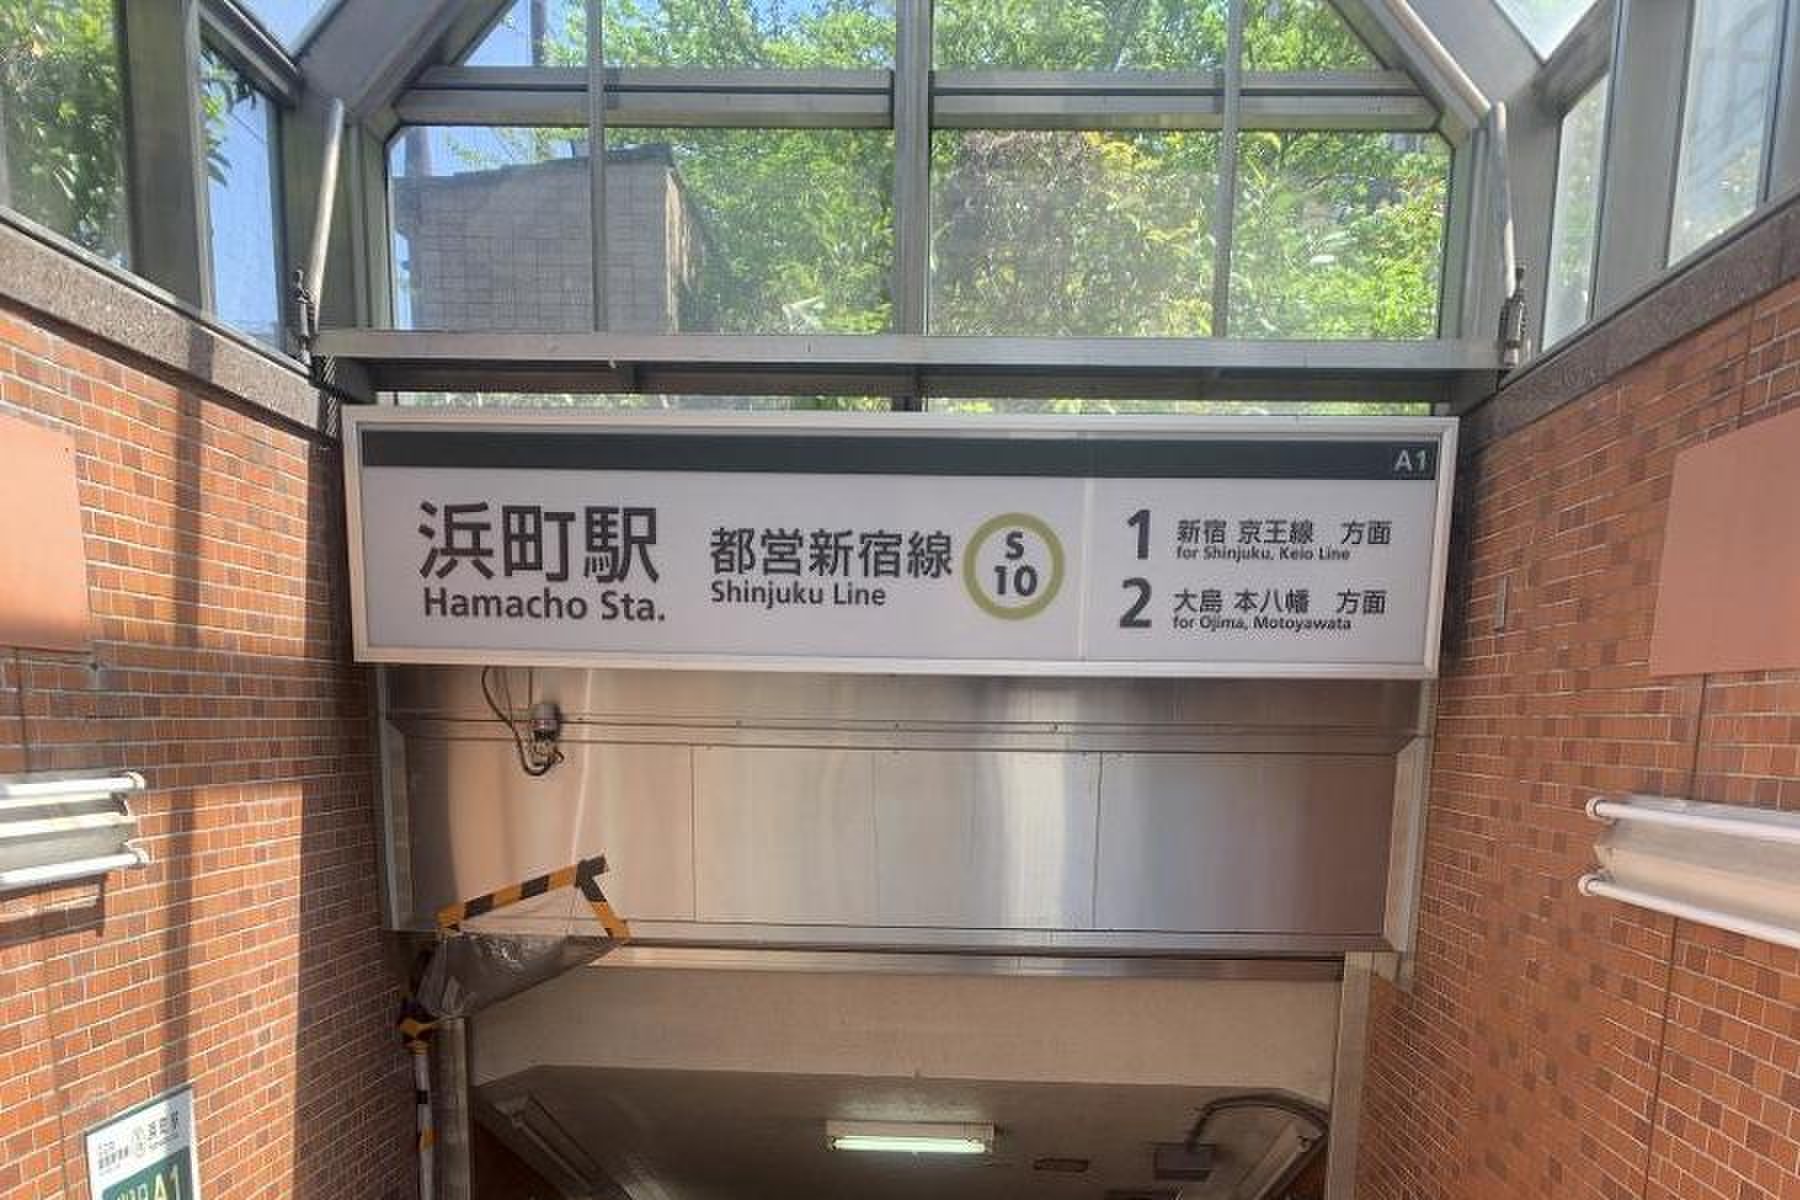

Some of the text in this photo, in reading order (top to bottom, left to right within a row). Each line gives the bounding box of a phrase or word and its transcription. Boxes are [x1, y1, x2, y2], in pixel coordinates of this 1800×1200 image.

[1394, 449, 1426, 471] A1
[418, 501, 659, 583] 浜町駅
[1005, 530, 1025, 561] S
[1127, 509, 1150, 560] 1
[1177, 519, 1392, 545] 新宿 京王線 方面
[710, 527, 952, 579] 都営新宿線
[1177, 546, 1197, 560] for
[1319, 546, 1350, 560] Line
[711, 580, 886, 609] Shinjuku Line
[994, 565, 1038, 596] 10
[423, 587, 665, 621] Hamacho Sta.
[1119, 577, 1152, 627] 2
[1174, 588, 1387, 614] 大島 本八幡 方面
[1173, 616, 1194, 630] for
[1253, 616, 1351, 633] Motoyawata
